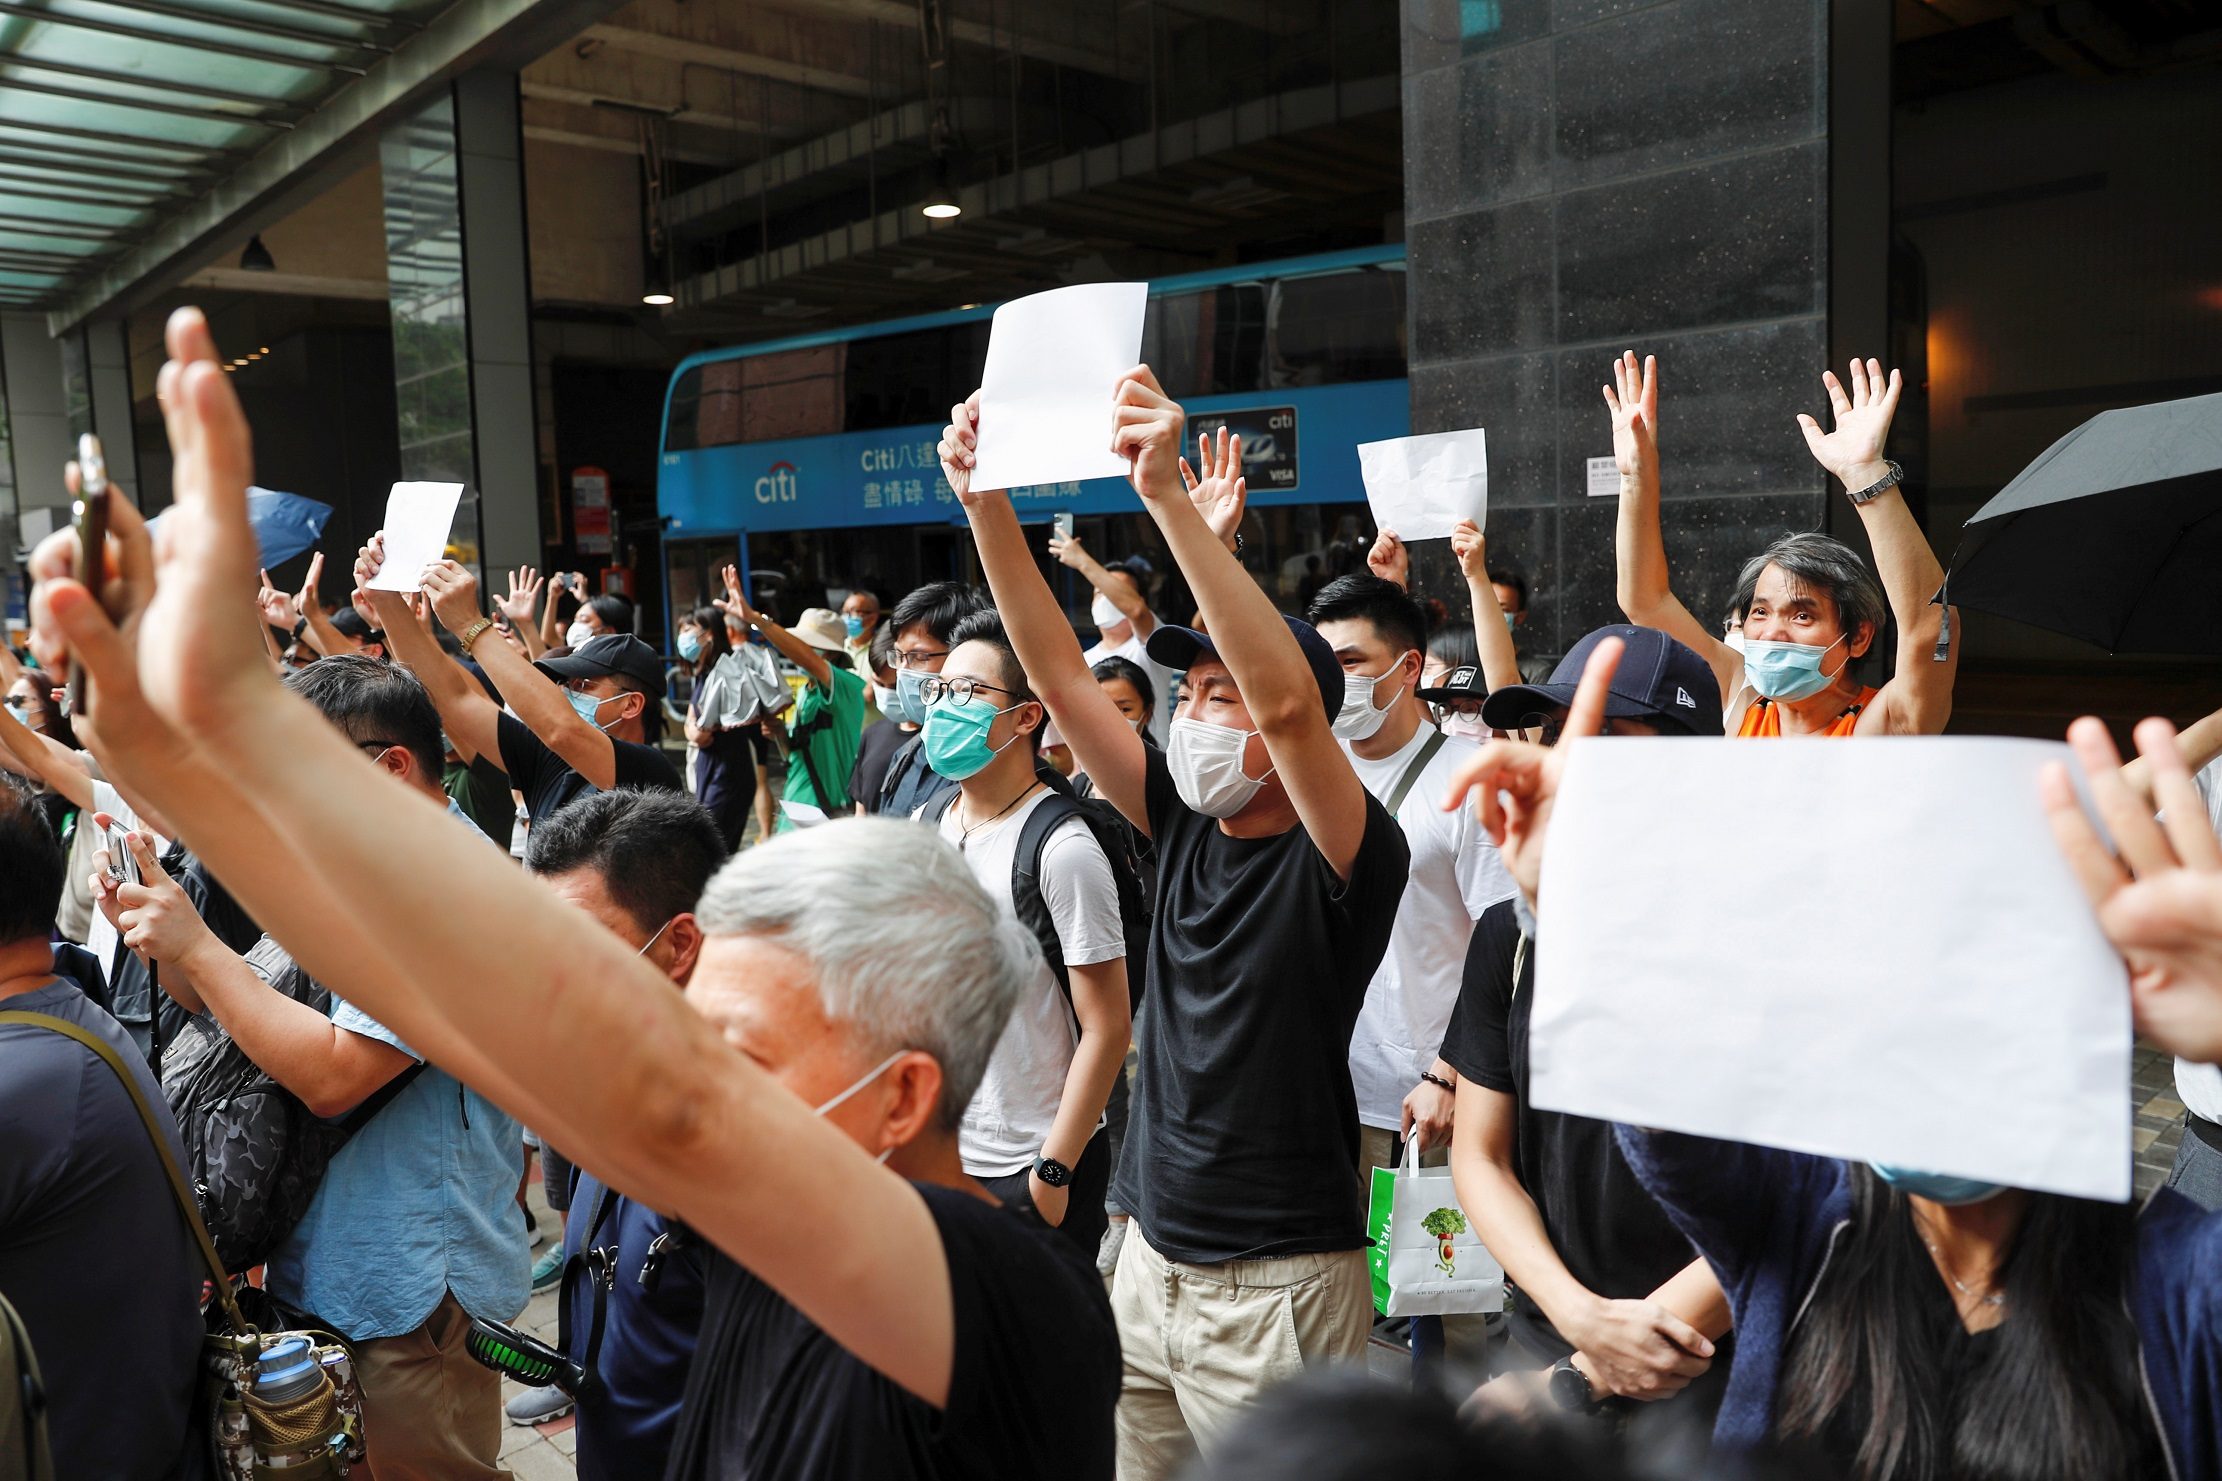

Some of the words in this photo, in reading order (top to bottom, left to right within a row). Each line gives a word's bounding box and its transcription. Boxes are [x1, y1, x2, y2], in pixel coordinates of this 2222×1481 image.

[755, 467, 797, 504] citi
[1269, 469, 1295, 482] VISA
[1377, 1223, 1391, 1258] PRET
